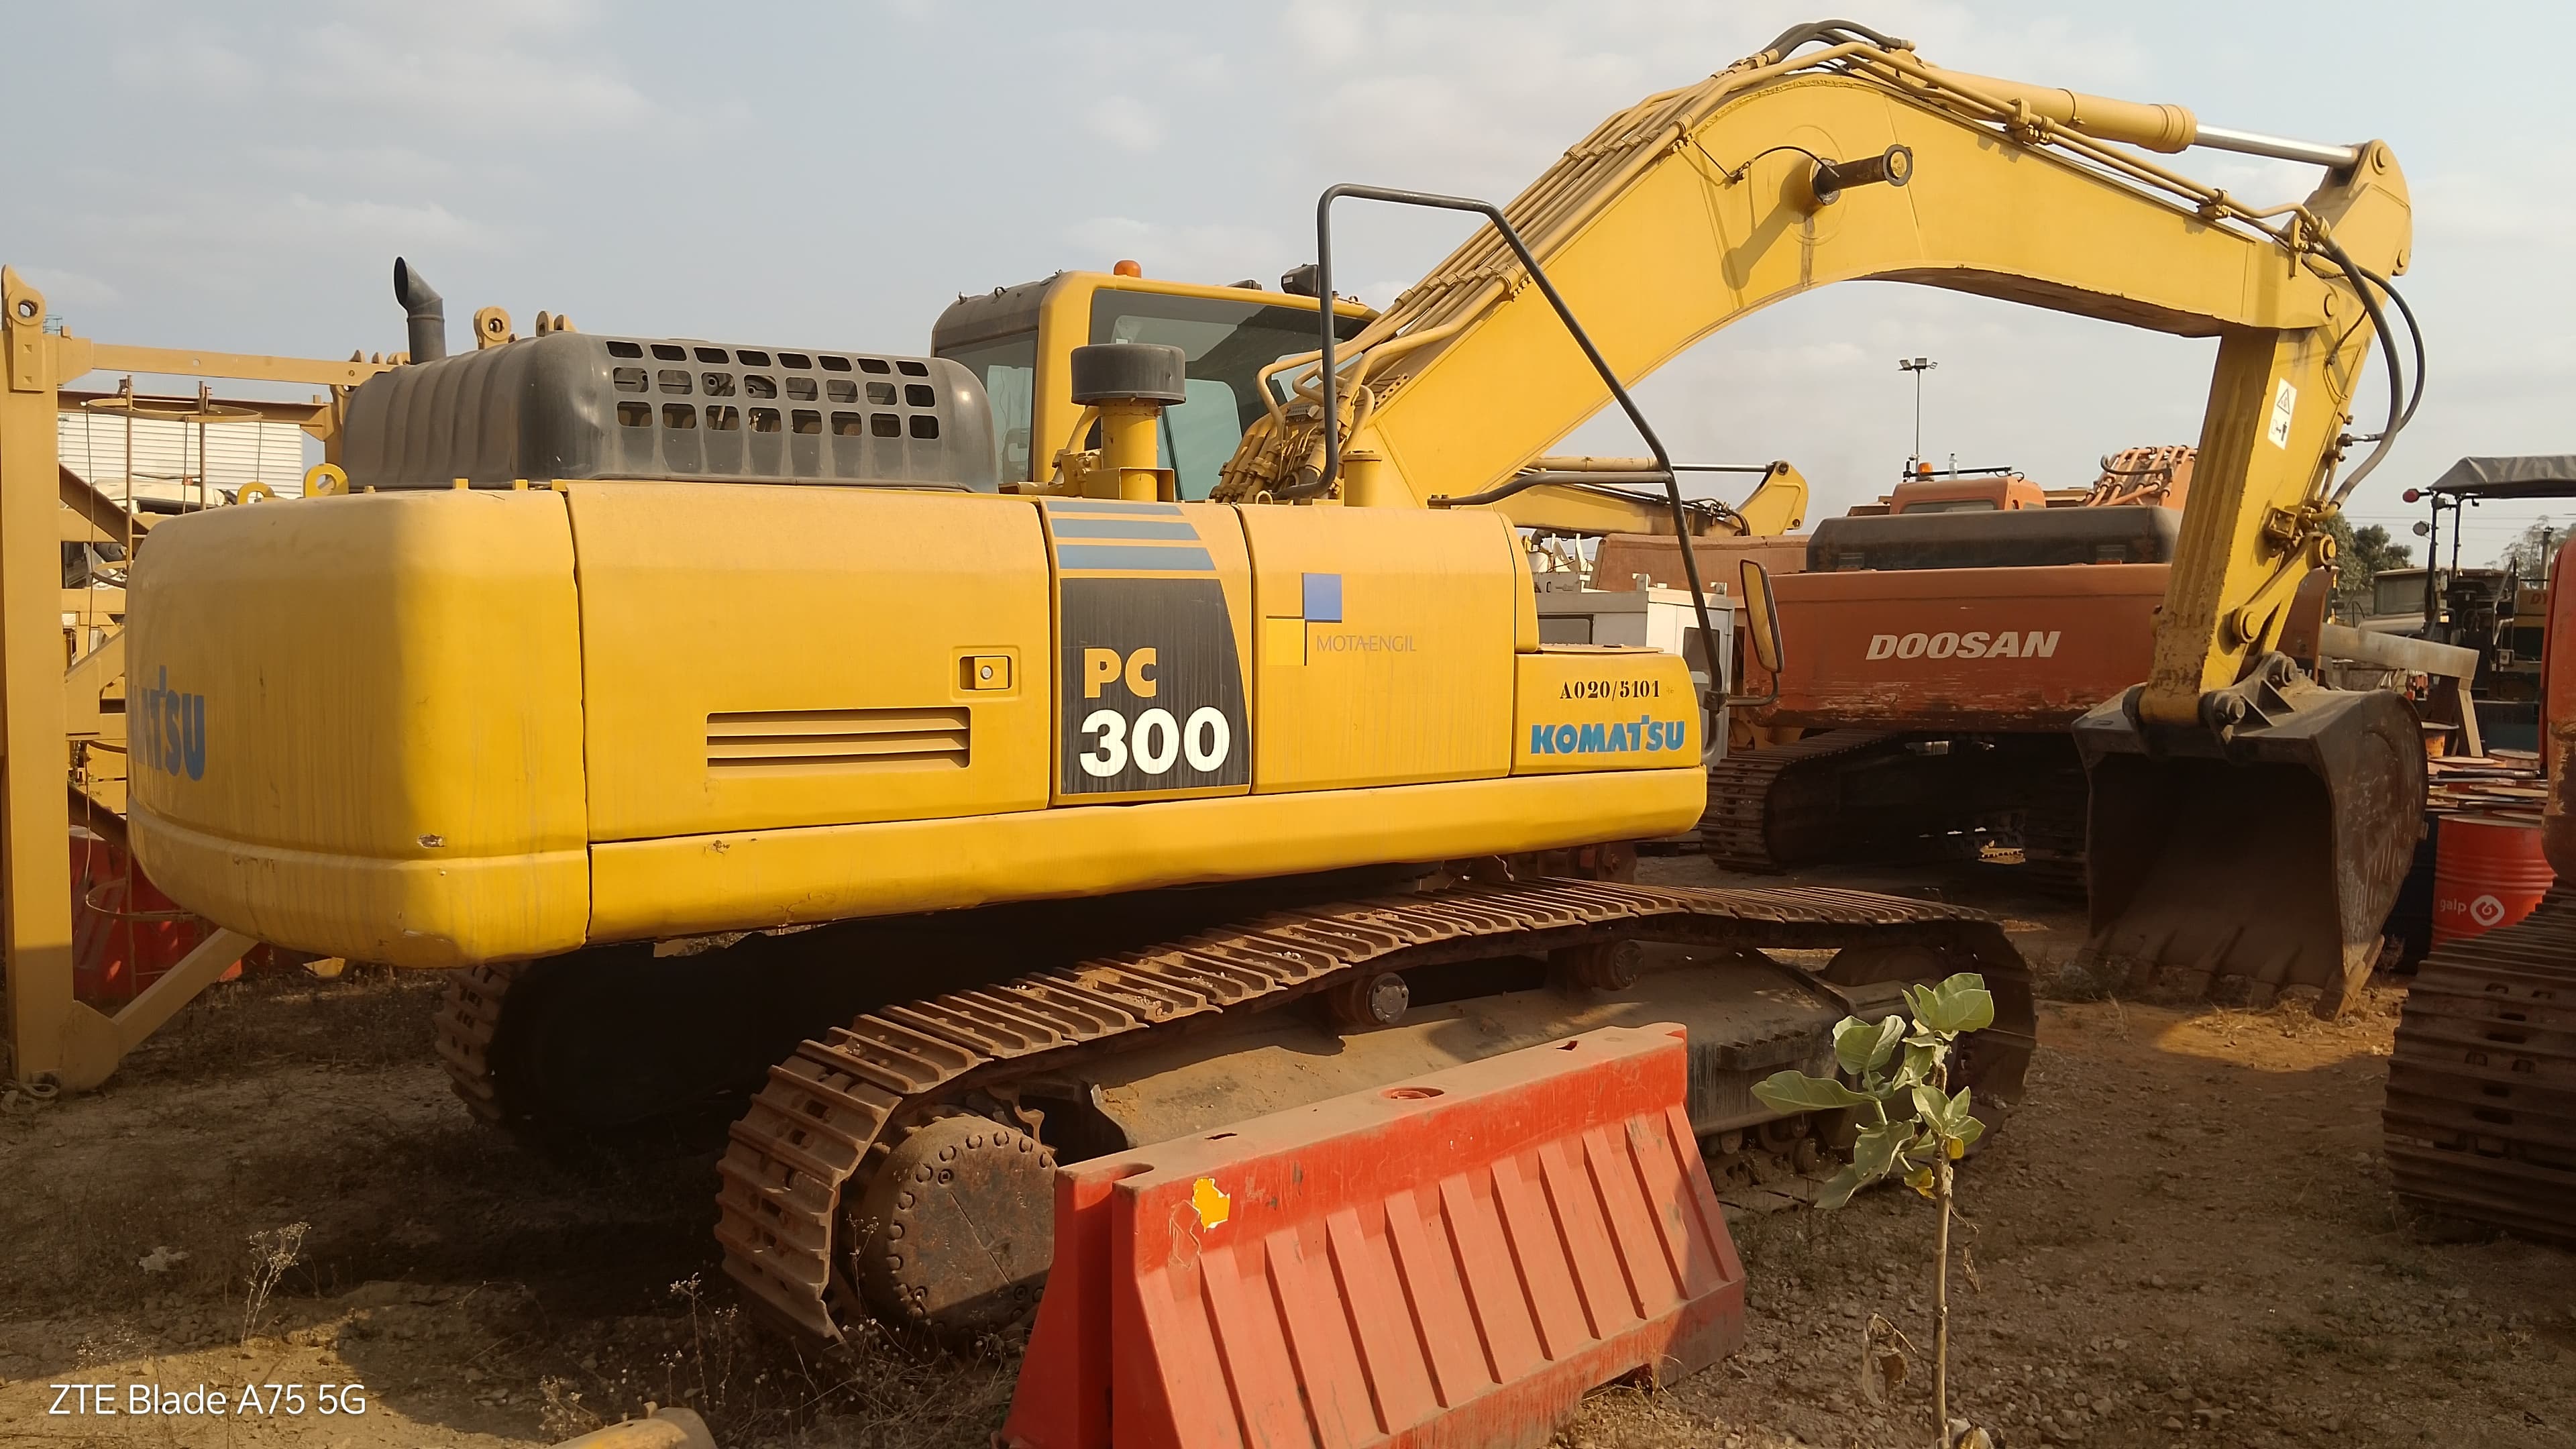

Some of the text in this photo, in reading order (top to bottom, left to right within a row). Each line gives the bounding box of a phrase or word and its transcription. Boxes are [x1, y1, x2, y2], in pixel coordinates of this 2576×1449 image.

[1865, 631, 2061, 660] DOOSAN
[1084, 647, 1157, 698] PC
[1560, 680, 1660, 702] A020/5101
[1079, 706, 1230, 777] 300
[1531, 714, 1685, 754] KOMATSU
[2440, 898, 2467, 916] galp
